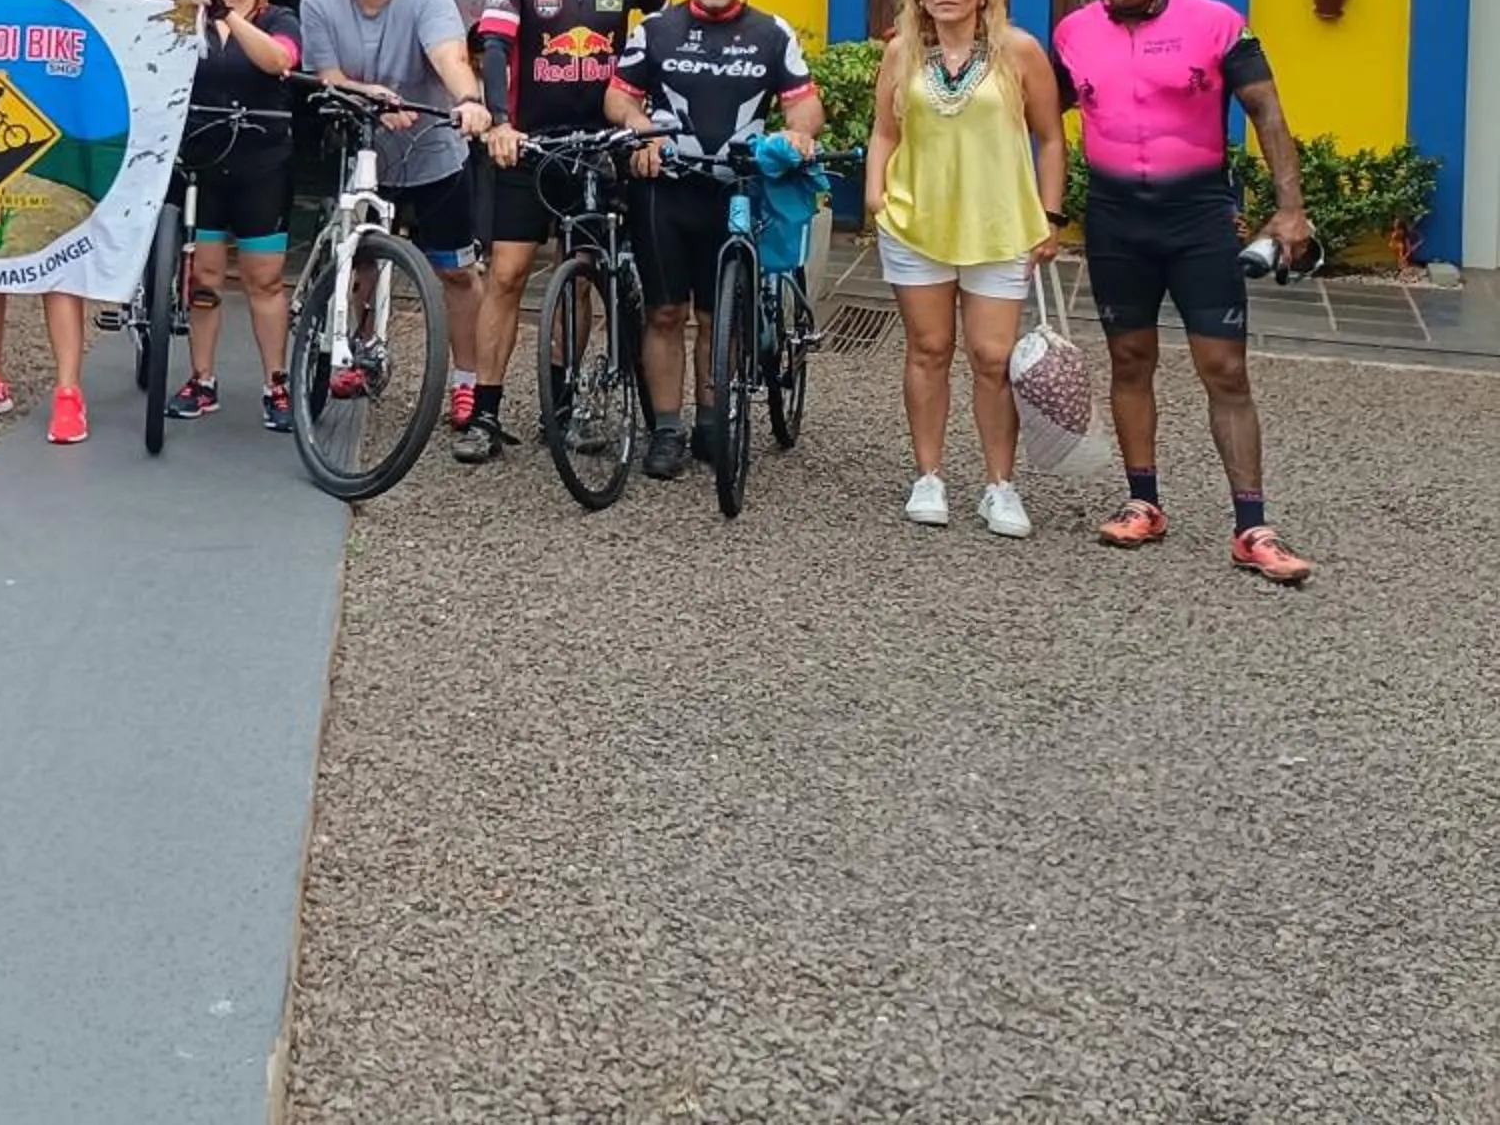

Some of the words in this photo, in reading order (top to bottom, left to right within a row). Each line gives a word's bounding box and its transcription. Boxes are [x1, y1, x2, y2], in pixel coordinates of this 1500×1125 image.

[27, 27, 85, 64] BIKE
[534, 56, 579, 82] Red
[582, 55, 617, 82] Bul
[662, 59, 767, 77] cervélo
